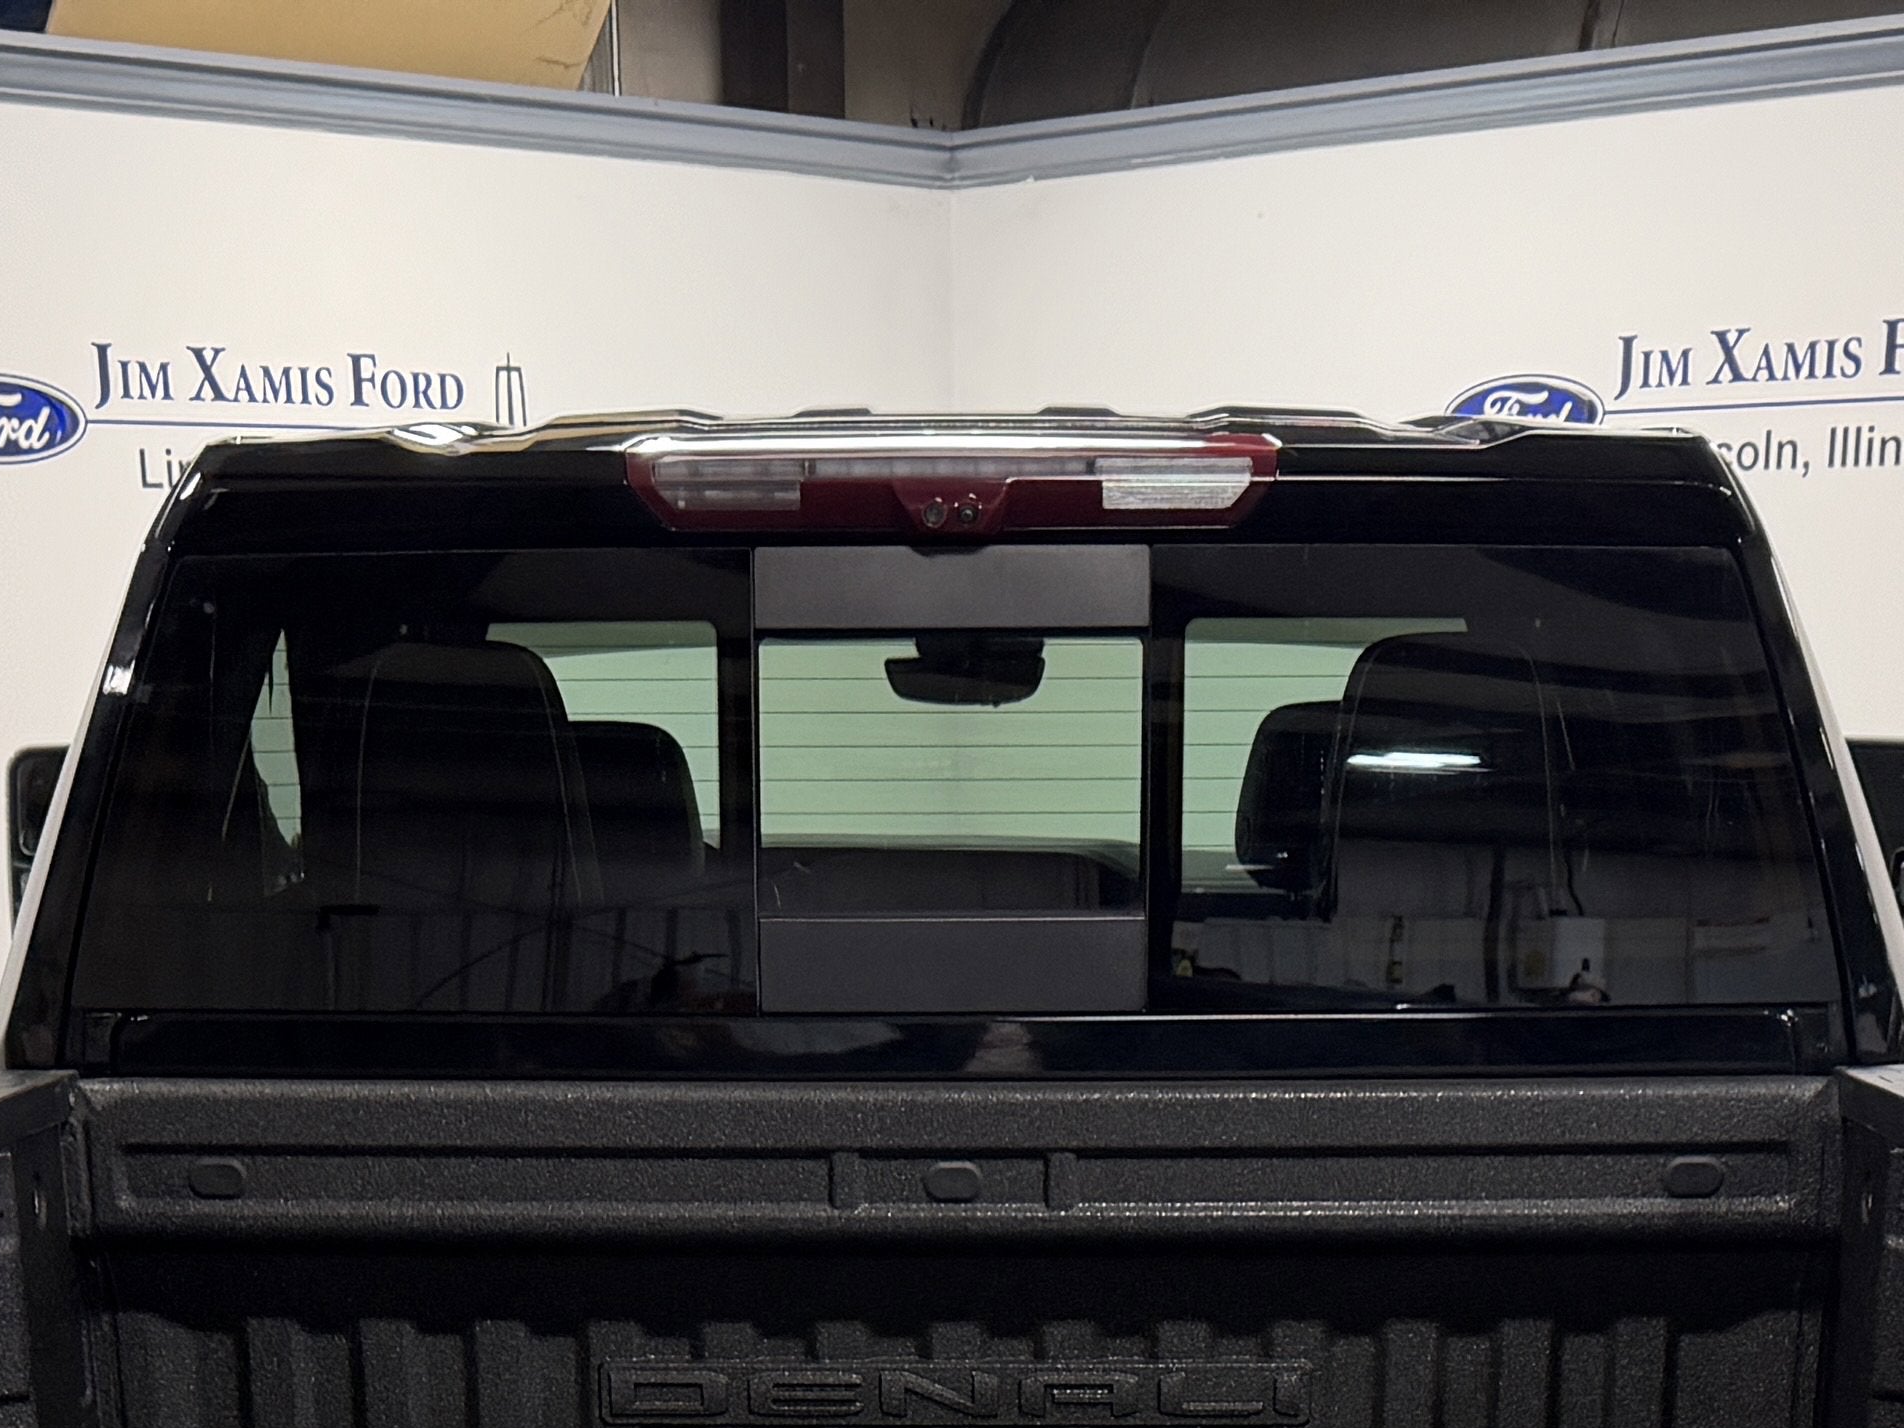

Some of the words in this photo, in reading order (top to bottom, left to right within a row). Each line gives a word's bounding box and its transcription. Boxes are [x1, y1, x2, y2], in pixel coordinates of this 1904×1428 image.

[90, 341, 176, 410] JIM
[185, 345, 335, 407] XAMIS
[346, 352, 465, 410] FORD
[1613, 334, 1693, 401] JIM
[1705, 327, 1863, 386] XAMIS
[608, 1367, 1302, 1418] DENALI
